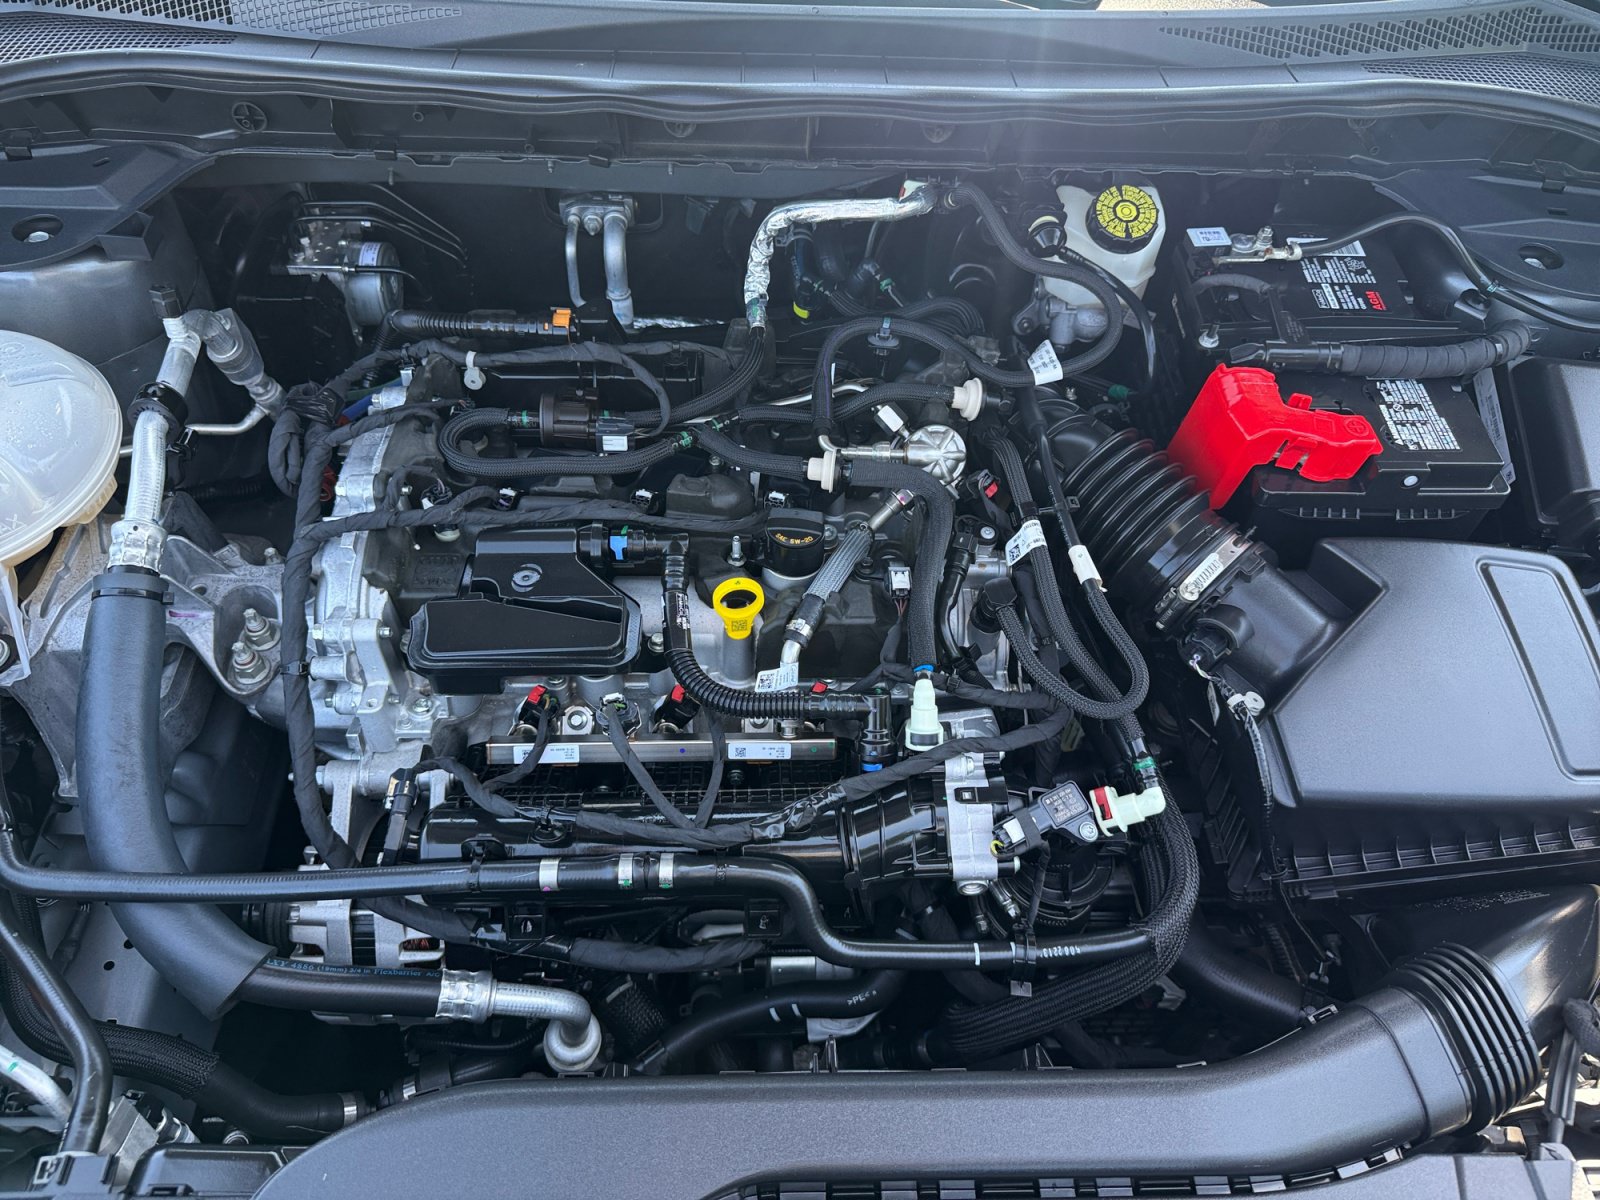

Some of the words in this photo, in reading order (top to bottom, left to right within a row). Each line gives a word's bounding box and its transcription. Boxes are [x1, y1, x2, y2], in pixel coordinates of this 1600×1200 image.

[1366, 291, 1383, 310] AGM
[775, 533, 788, 543] SAE
[789, 536, 814, 545] 5W-20
[317, 965, 348, 974] (19mm)
[373, 967, 422, 977] Flexbarrier
